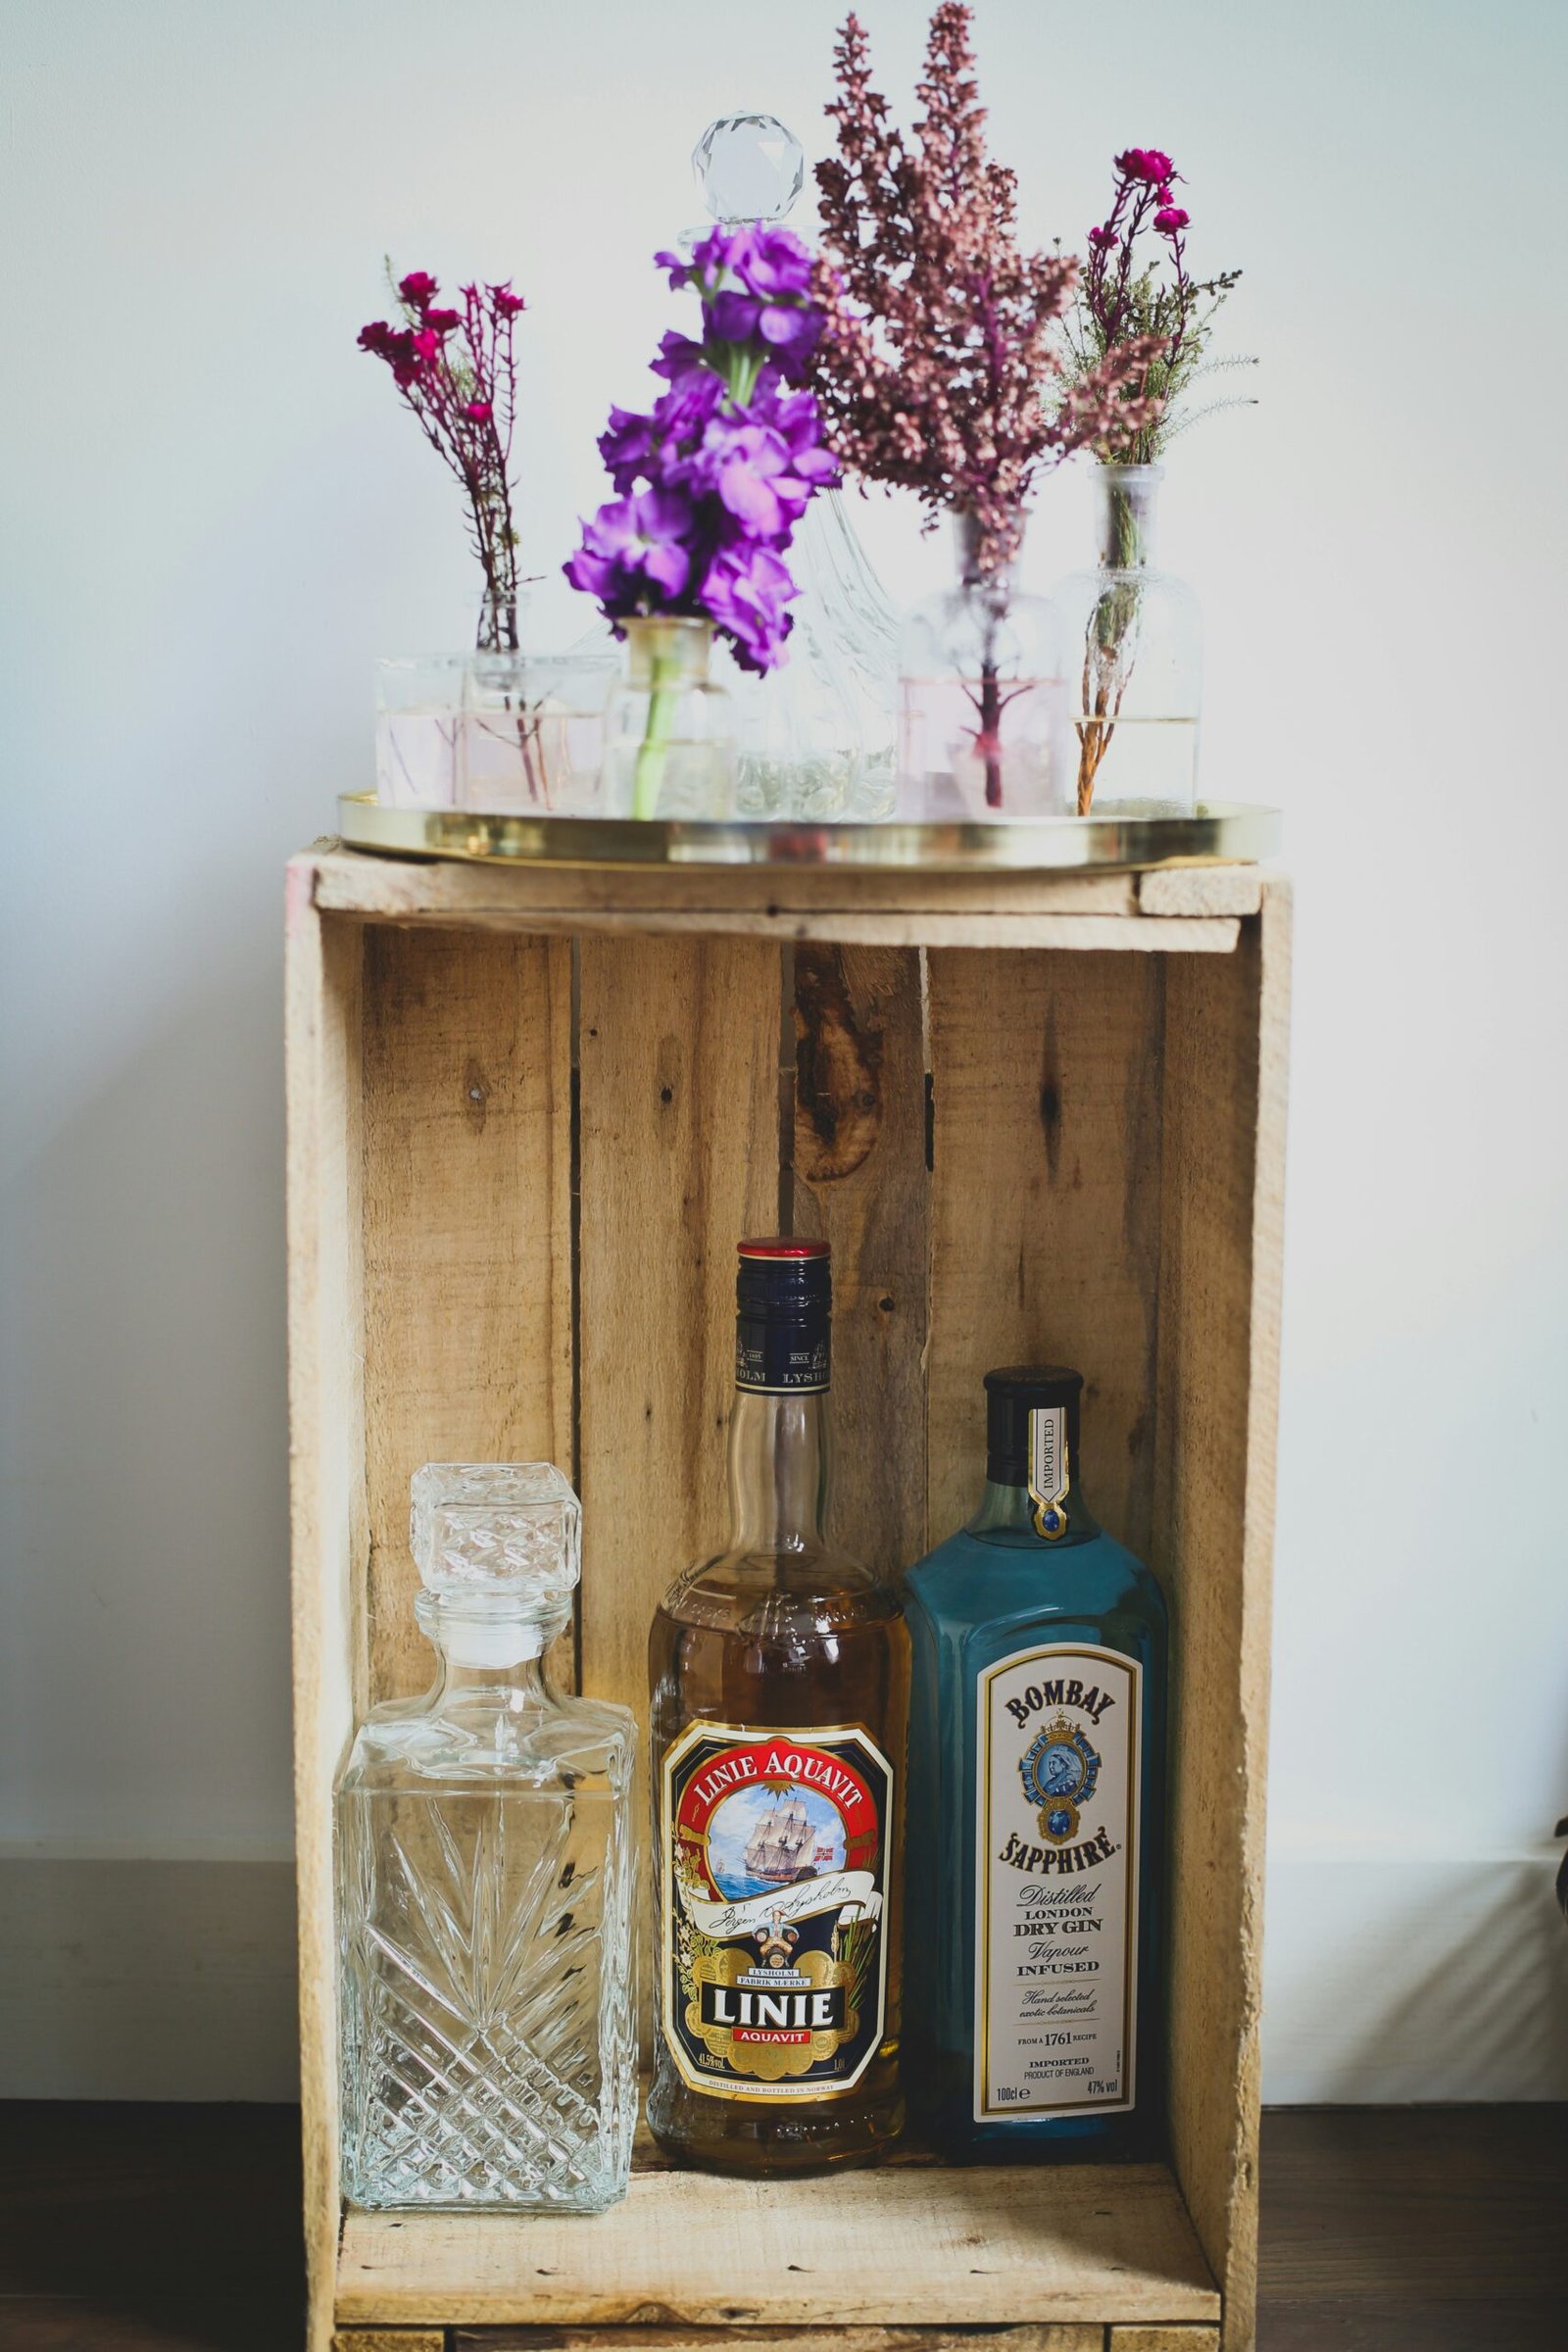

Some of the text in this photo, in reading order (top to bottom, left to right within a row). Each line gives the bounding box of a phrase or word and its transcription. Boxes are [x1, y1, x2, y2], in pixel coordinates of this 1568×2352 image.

[782, 1372, 829, 1384] LYSH
[1044, 1419, 1054, 1489] IMPORTED
[1004, 1680, 1115, 1729] BOMBAY
[693, 1751, 863, 1810] LINIE AQUAVIT
[1016, 1883, 1102, 1907] Distilled
[1024, 1907, 1095, 1920] LONDON
[1013, 1919, 1103, 1936] DRY GIN
[1028, 1940, 1090, 1963] Vapour
[1016, 1961, 1100, 1976] INFUSED
[740, 1978, 808, 1986] FABRIK MÆRKE
[1022, 1988, 1096, 2004] Hand selected
[713, 1988, 834, 2028] LINIE
[1019, 2000, 1098, 2017] exotic botanicals
[740, 2032, 805, 2042] AQUAVIT
[1045, 2033, 1072, 2046] 1761
[1029, 2057, 1090, 2068] IMPORTED
[1024, 2067, 1095, 2080] PRODUCT OF ENGLAND
[709, 2080, 744, 2091] DISTILLED
[806, 2084, 834, 2093] NORWAY
[1088, 2080, 1117, 2094] 47% vol
[997, 2087, 1017, 2101] 100cl
